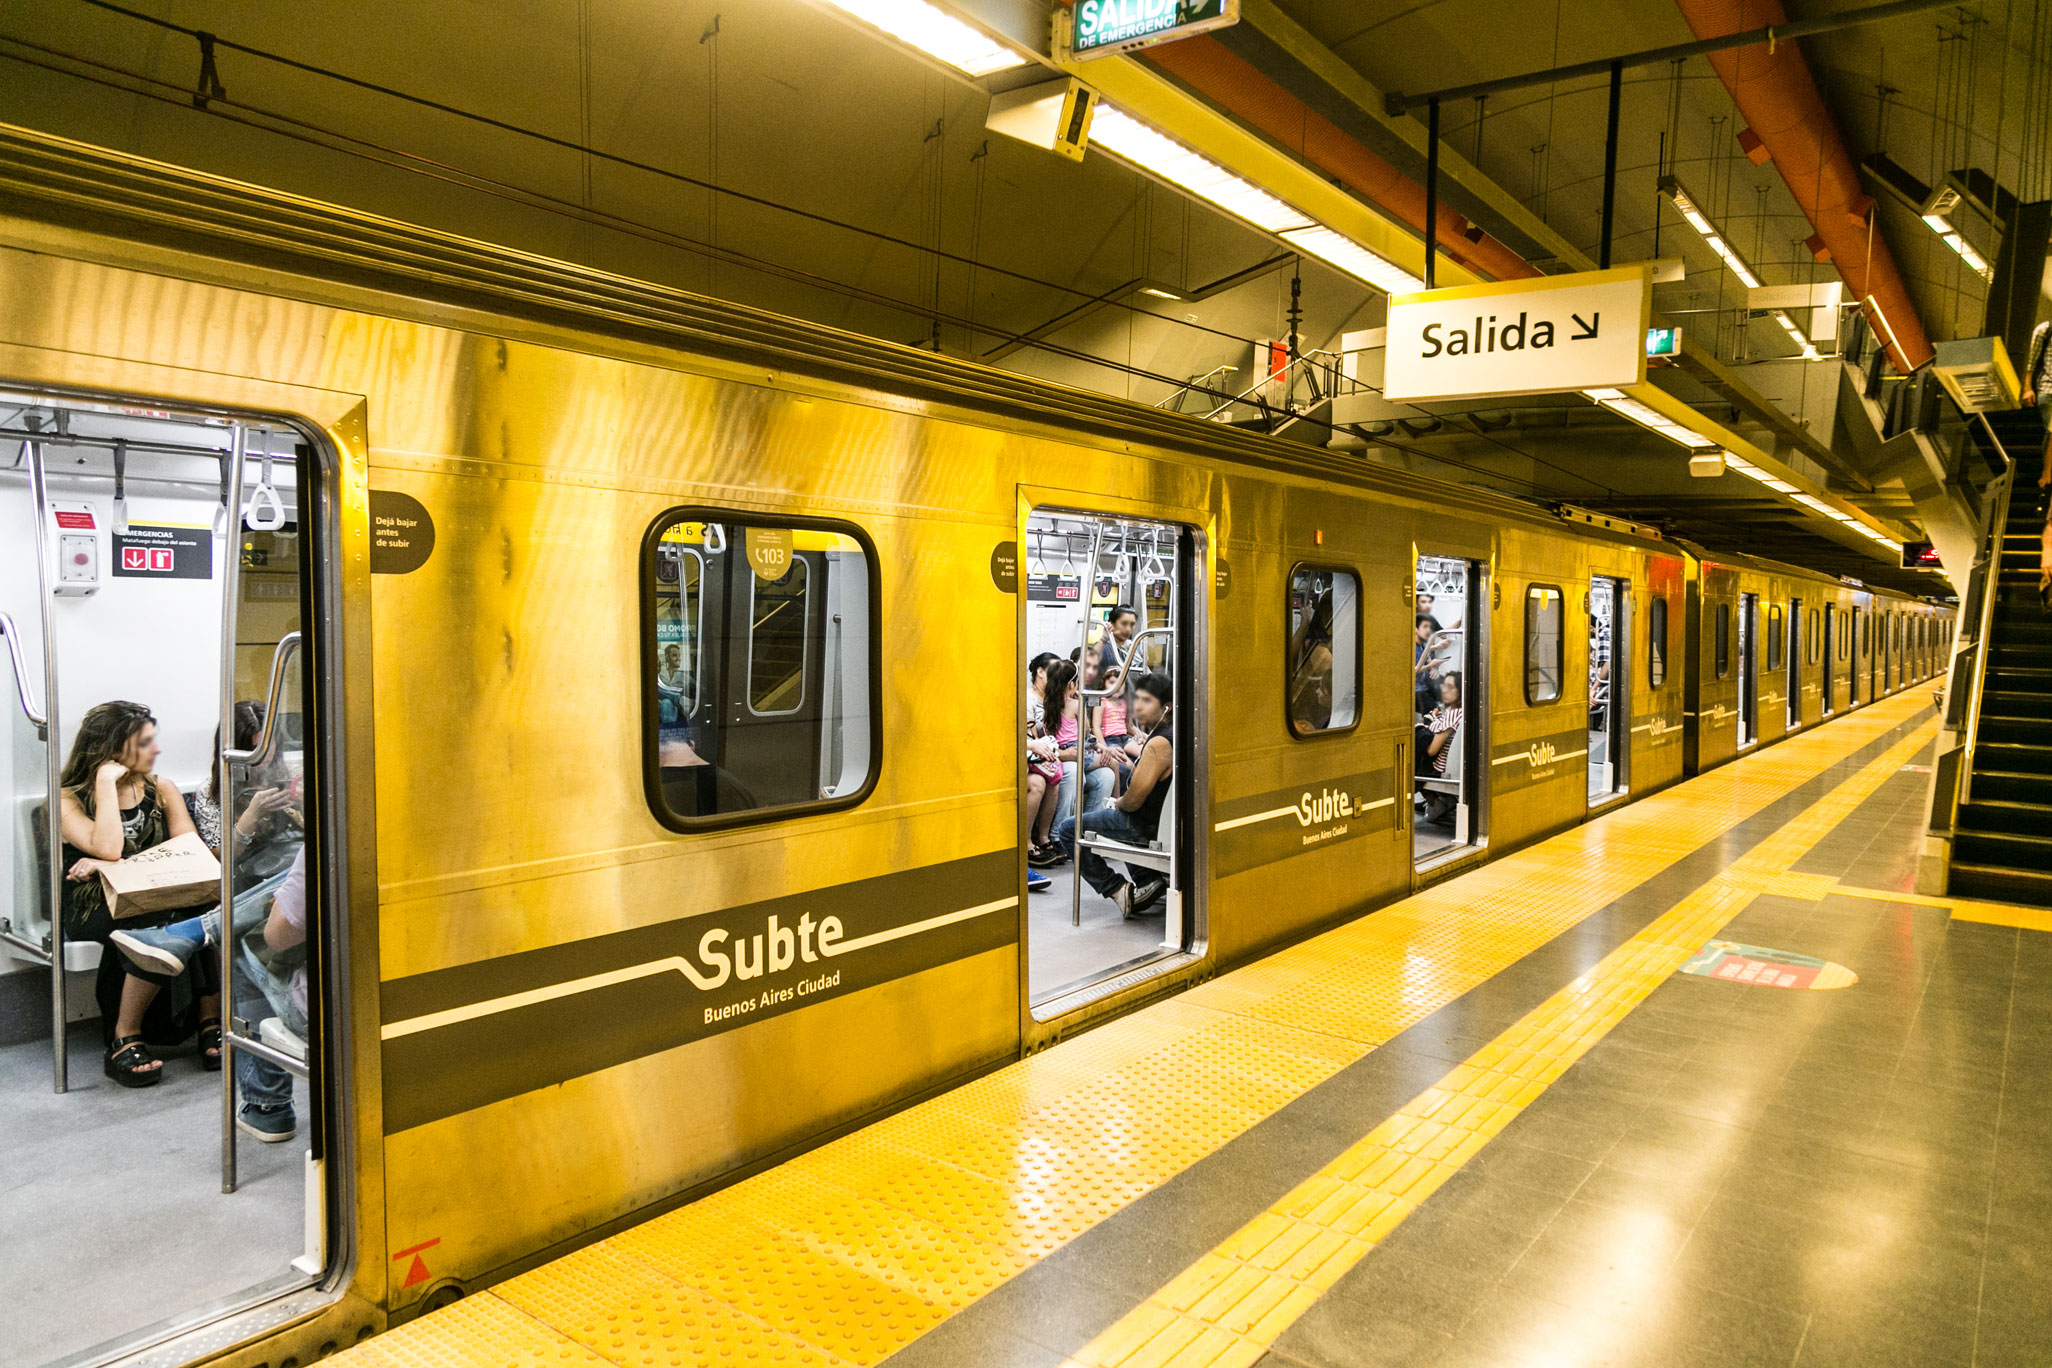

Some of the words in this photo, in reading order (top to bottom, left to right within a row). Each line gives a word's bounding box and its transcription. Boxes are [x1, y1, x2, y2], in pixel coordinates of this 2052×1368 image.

[1080, 34, 1097, 49] DE
[1100, 11, 1186, 44] EMERGENCIA
[1422, 312, 1555, 358] Salida
[375, 516, 395, 527] Dejá
[396, 517, 418, 528] bajar
[122, 537, 151, 545] Matafuego
[151, 538, 170, 546] debajo
[126, 529, 174, 539] MERGENCIAS
[376, 529, 399, 537] antes
[376, 538, 388, 547] de
[389, 539, 410, 548] subir
[761, 547, 785, 565] 103
[1530, 741, 1555, 767] Subte
[1301, 788, 1349, 827] Subte
[1302, 834, 1320, 845] Buenos
[1320, 830, 1332, 840] Aires
[1332, 824, 1348, 837] Ciudad
[698, 911, 844, 991] Subte
[704, 998, 756, 1025] Buenos
[759, 986, 794, 1009] Aires
[797, 969, 841, 997] Ciudad
